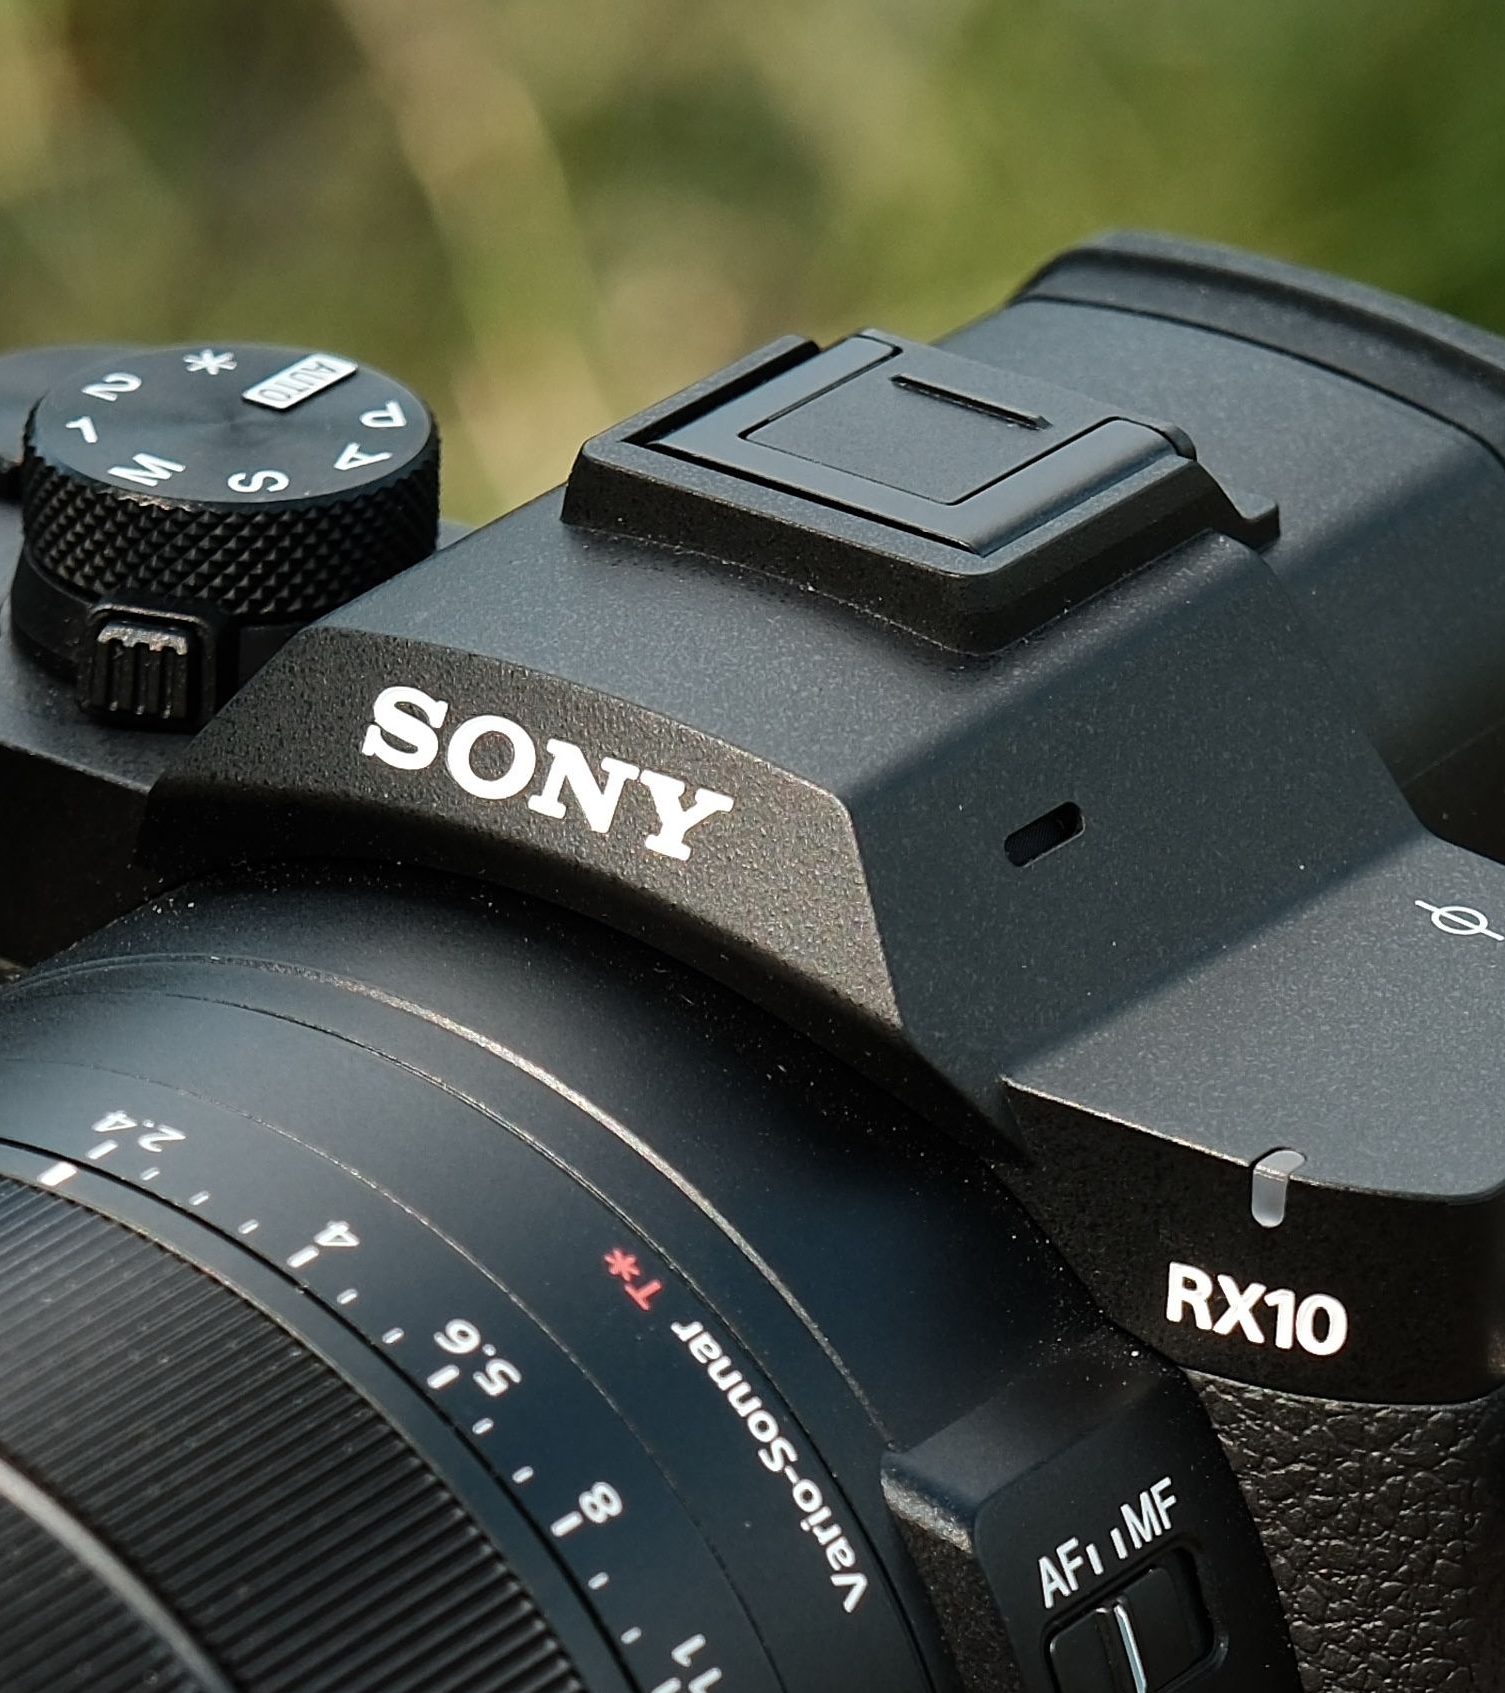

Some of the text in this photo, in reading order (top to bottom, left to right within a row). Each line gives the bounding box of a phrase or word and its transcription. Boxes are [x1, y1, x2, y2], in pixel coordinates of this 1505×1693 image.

[81, 372, 142, 402] 2
[250, 357, 340, 405] AUTO
[359, 399, 408, 429] P
[107, 453, 186, 487] M
[334, 443, 392, 471] A
[227, 470, 289, 493] S
[361, 686, 734, 862] SONY
[92, 1109, 186, 1153] 2.4
[314, 1220, 361, 1251] 4
[1166, 1262, 1347, 1356] RX10
[433, 1318, 522, 1396] 5.6
[670, 1318, 869, 1613] Vario-Sonnar
[579, 1481, 624, 1525] 8
[1038, 1475, 1178, 1609] AF MF
